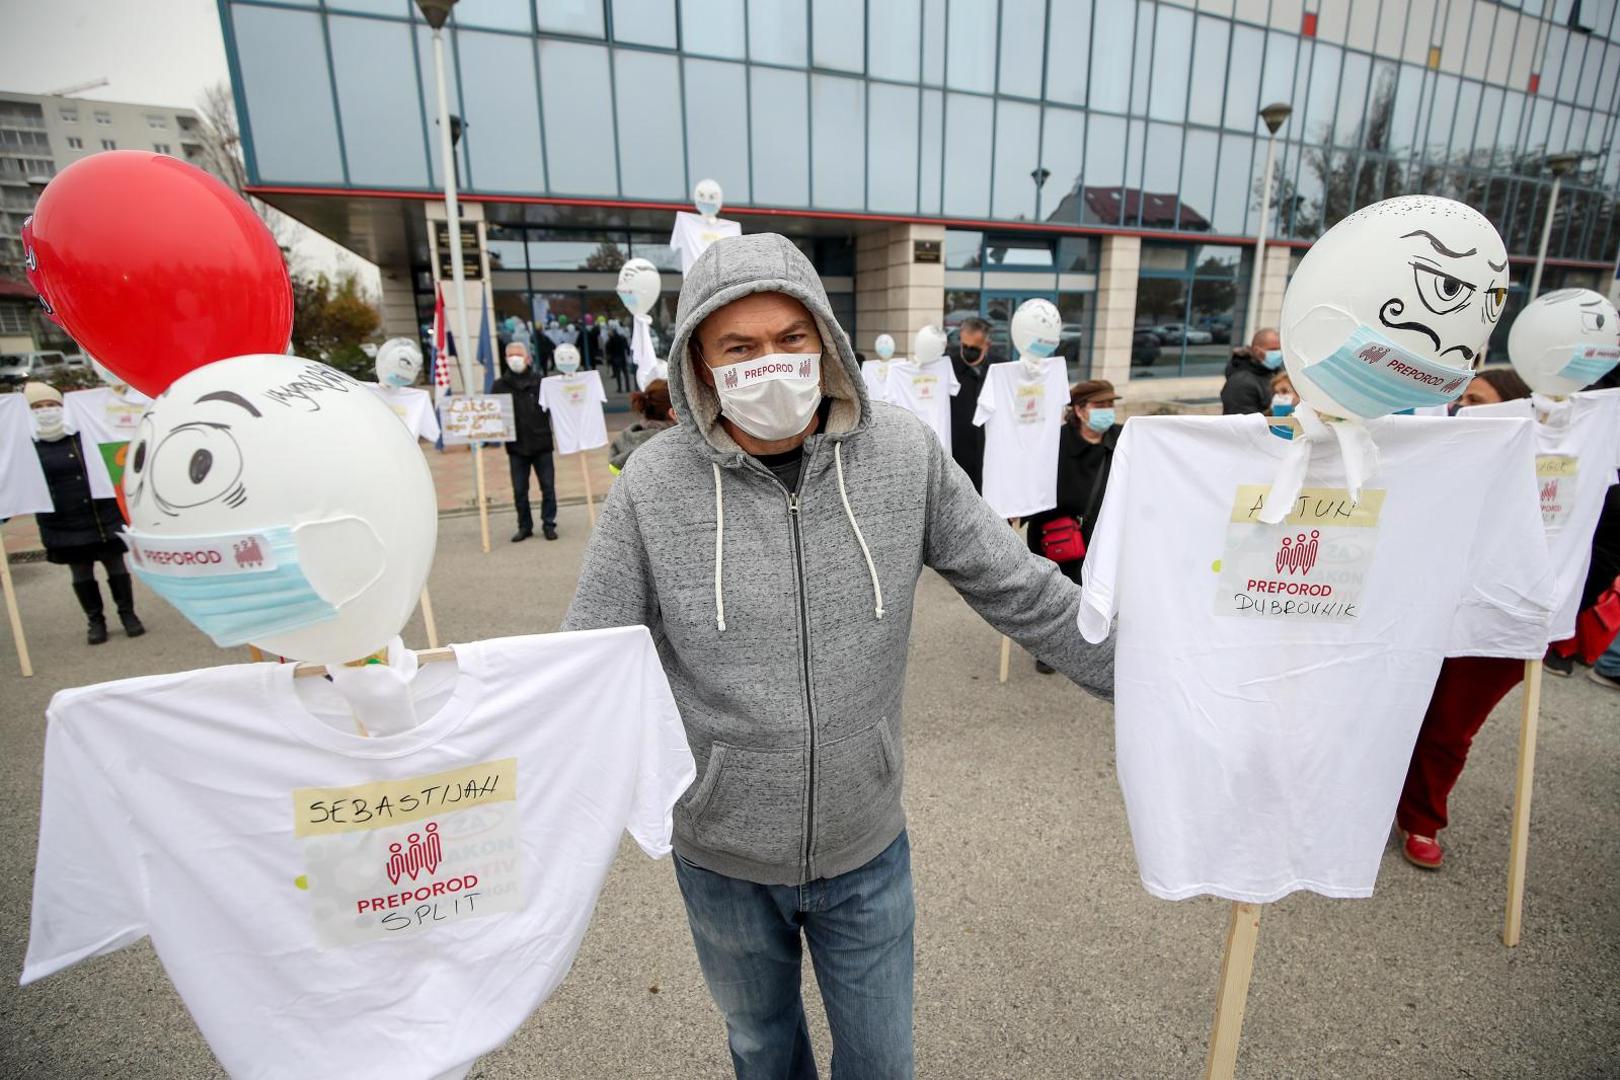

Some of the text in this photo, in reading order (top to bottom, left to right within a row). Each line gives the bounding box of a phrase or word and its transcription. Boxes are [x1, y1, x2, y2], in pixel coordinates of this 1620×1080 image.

[744, 363, 794, 380] PREPOROD
[1386, 359, 1445, 386] PREPOROD
[1248, 494, 1359, 519] ATUN
[143, 549, 222, 566] PREPOROD
[1246, 579, 1332, 597] PREPOROD
[1234, 593, 1358, 618] DUBROVNIK
[309, 774, 499, 824] SEBASTIJAN
[356, 874, 479, 914] PREPOROD
[381, 892, 481, 931] SPLIT
